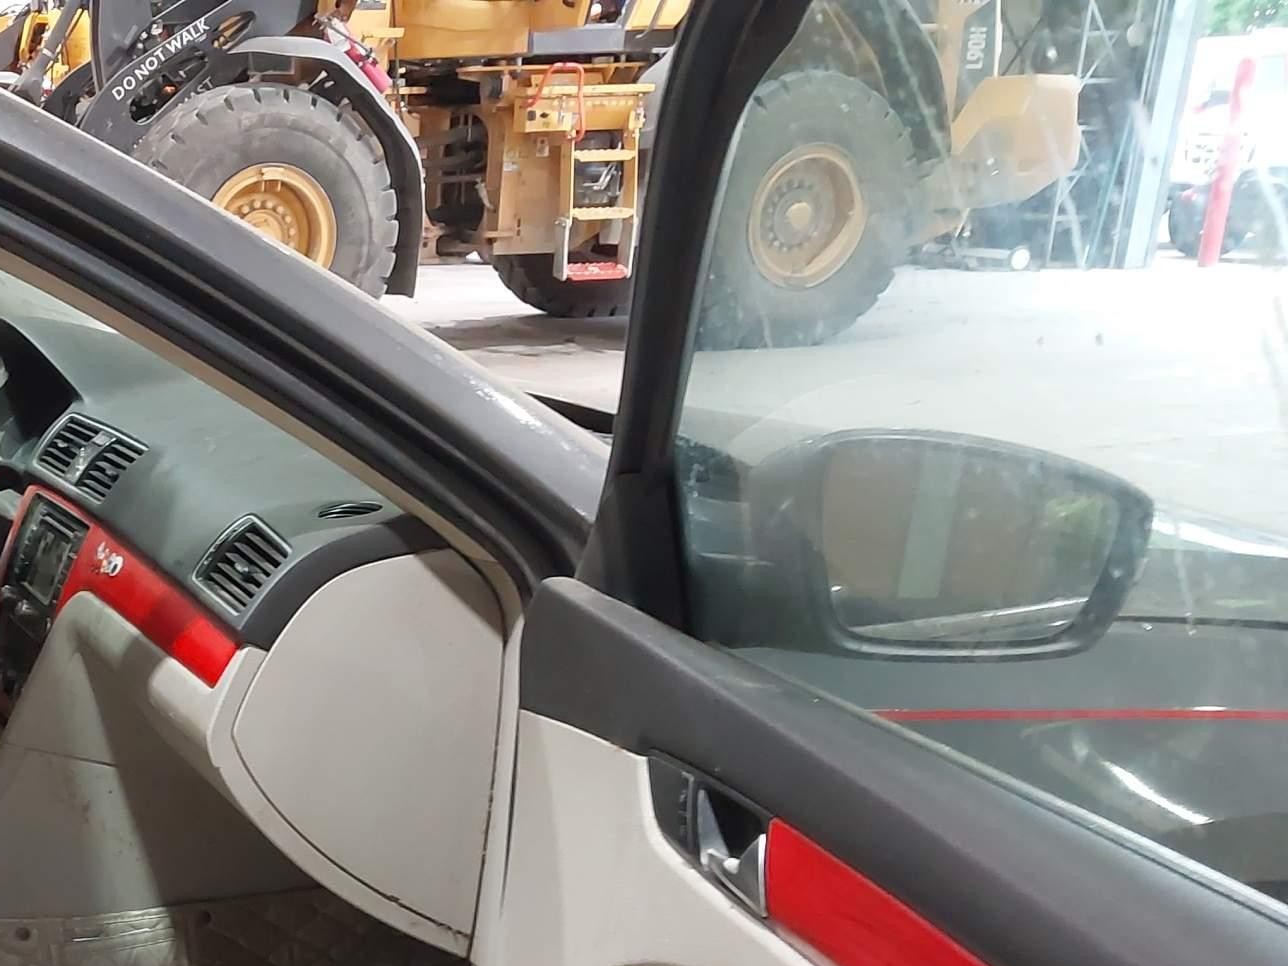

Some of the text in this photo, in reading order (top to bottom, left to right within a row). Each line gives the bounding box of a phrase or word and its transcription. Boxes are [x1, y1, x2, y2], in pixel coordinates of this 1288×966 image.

[112, 17, 211, 101] DO NOT WALK
